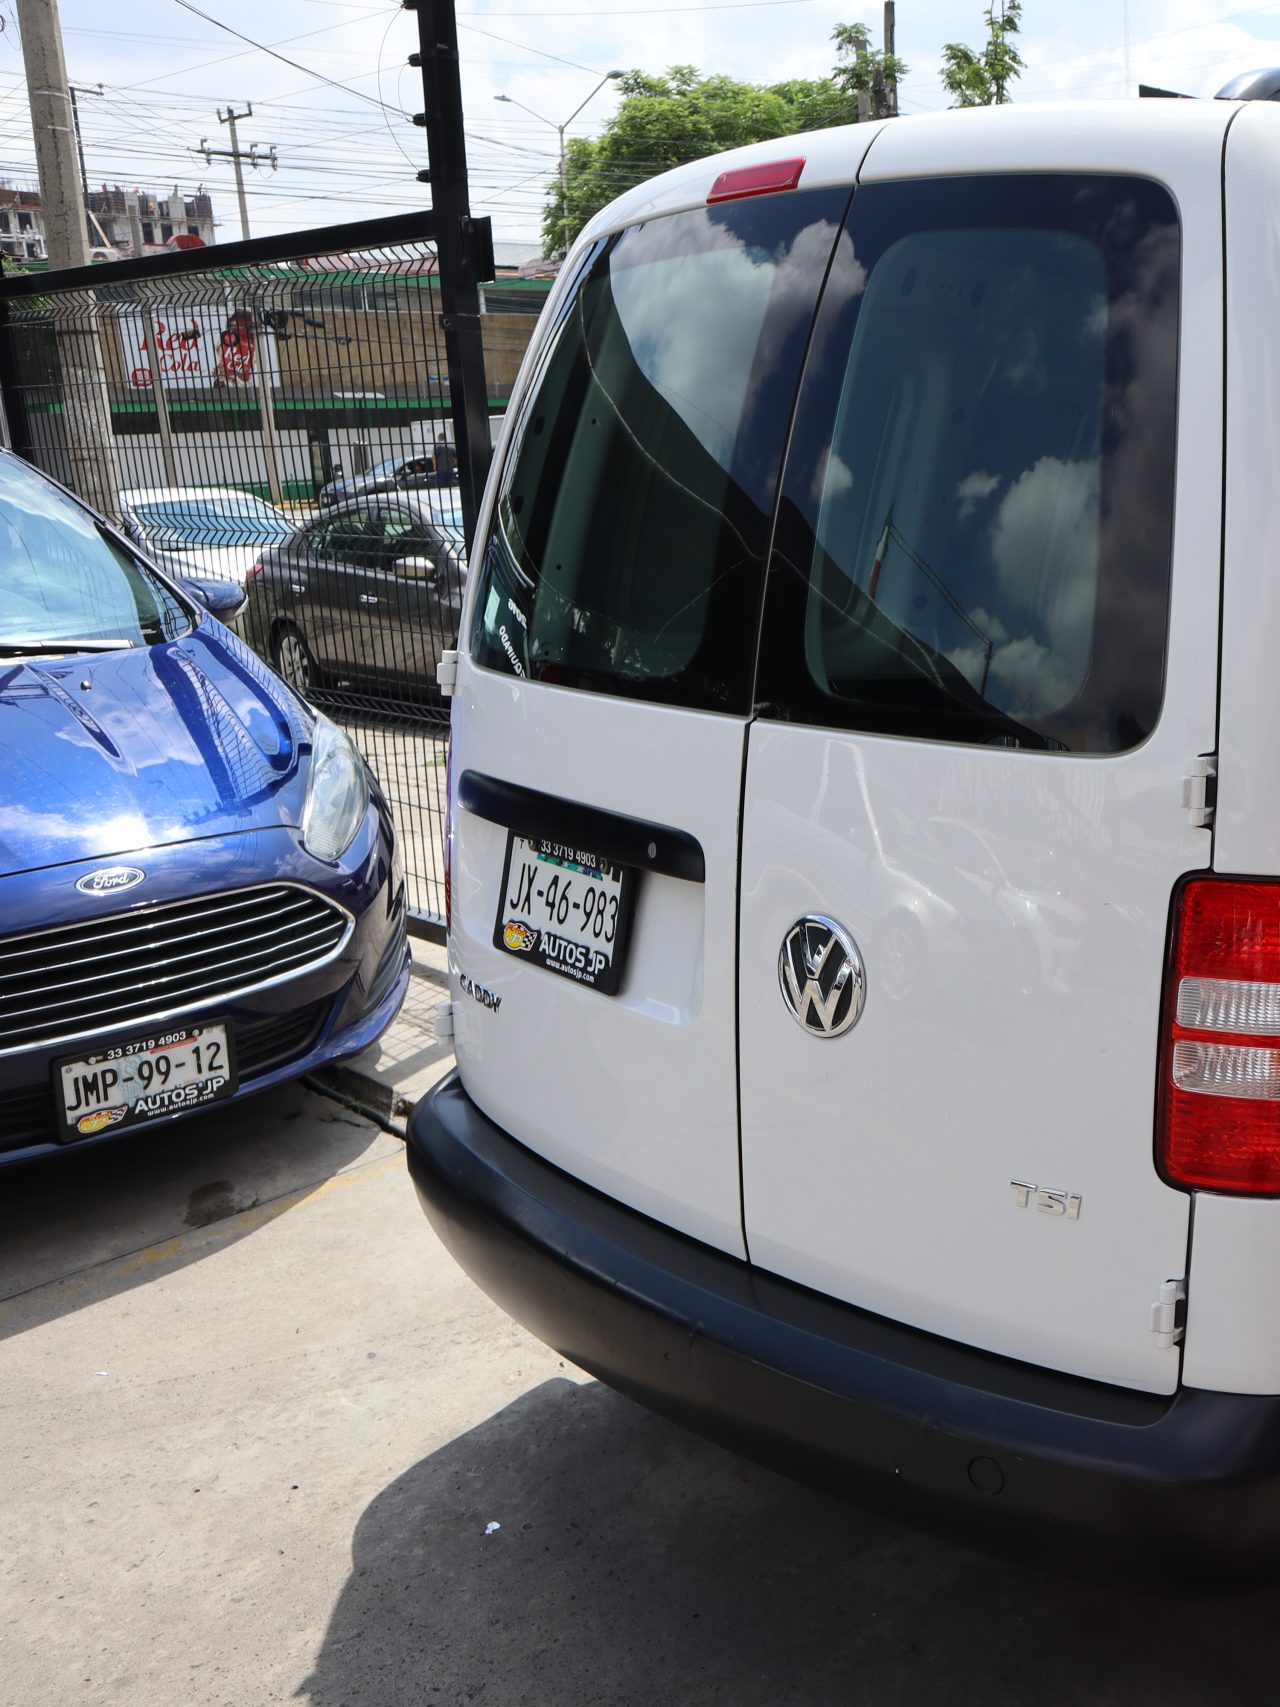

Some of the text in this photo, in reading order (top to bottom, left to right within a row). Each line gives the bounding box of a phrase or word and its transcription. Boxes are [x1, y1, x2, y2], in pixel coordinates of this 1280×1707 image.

[159, 353, 201, 373] Cola
[540, 840, 596, 868] 33 3719 4903
[92, 871, 130, 890] Ford
[509, 862, 620, 944] JX-46-983
[538, 933, 606, 975] AUTOS JP
[545, 957, 595, 983] www.autosjp.com
[460, 974, 502, 1014] CADDY
[107, 1031, 187, 1060] 33 3719 4903
[66, 1041, 224, 1112] JMP-99-12
[134, 1076, 226, 1115] AUTOS JP
[147, 1092, 215, 1117] www.autosjp.com
[1010, 1179, 1082, 1220] TSI
